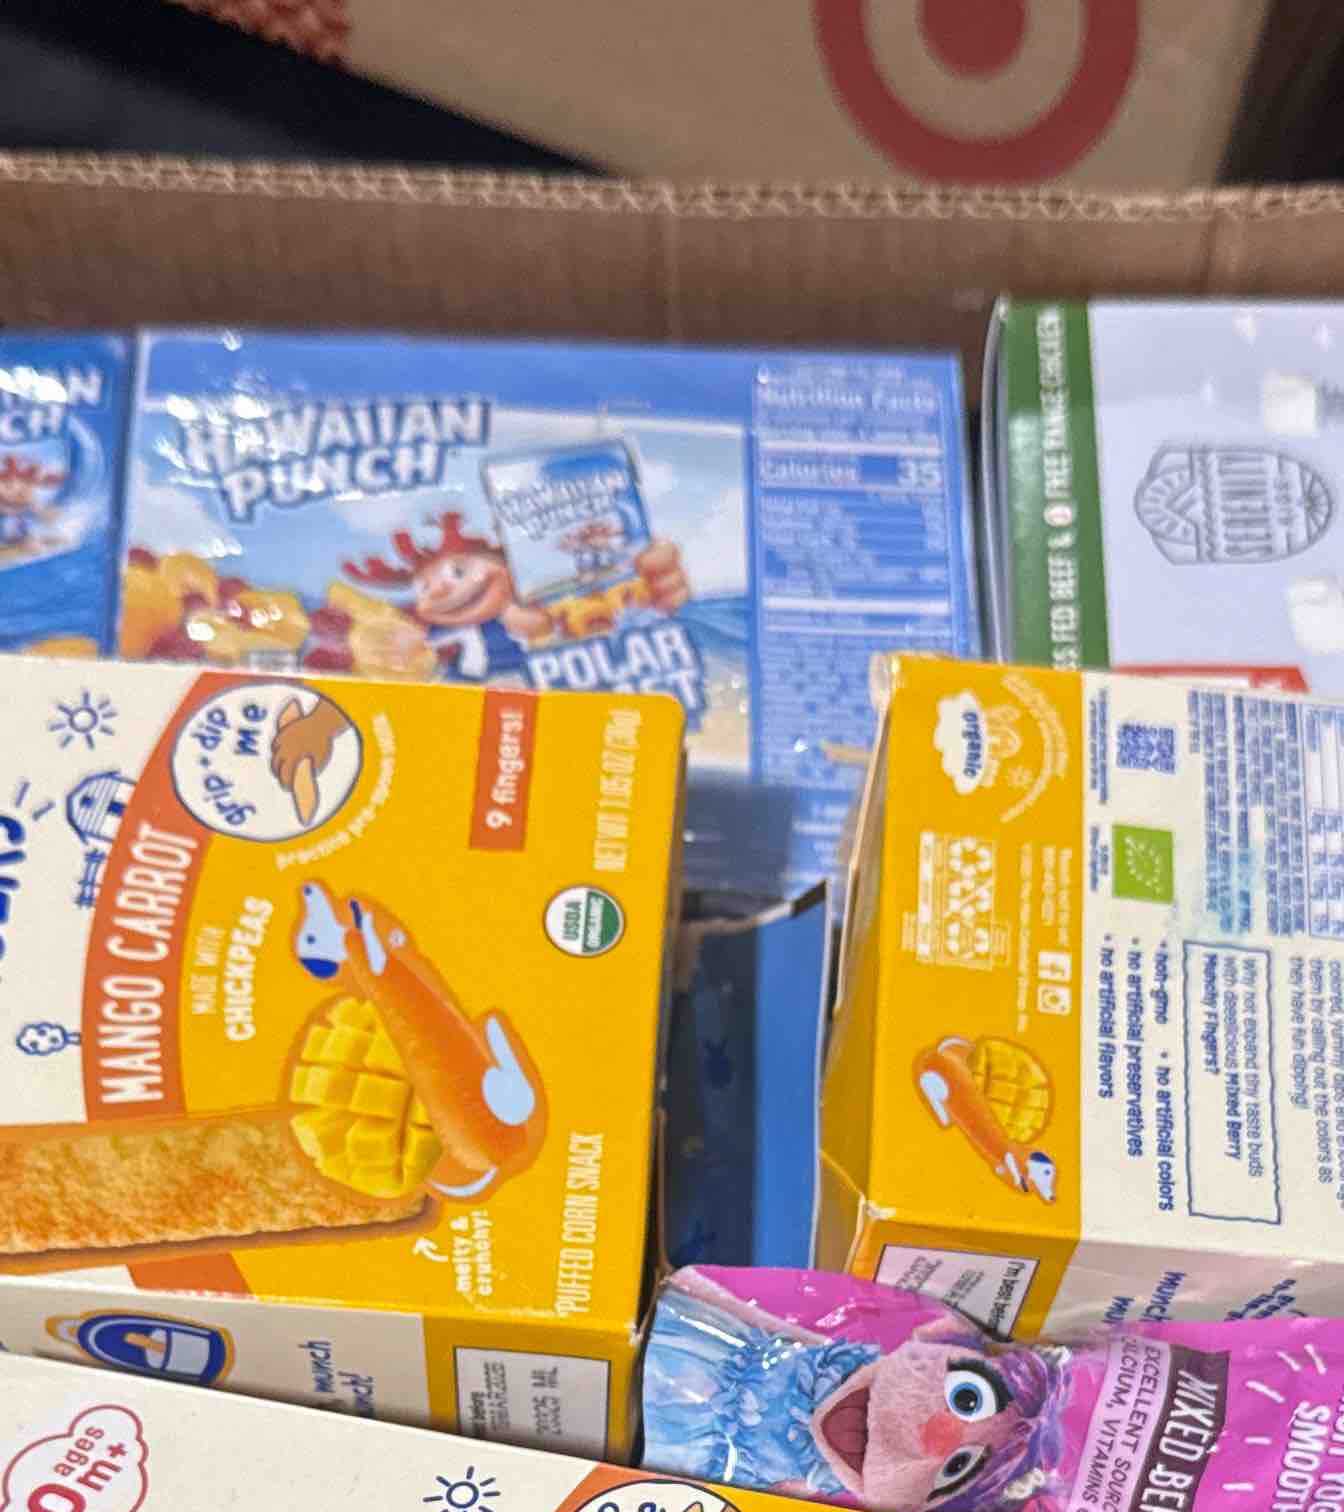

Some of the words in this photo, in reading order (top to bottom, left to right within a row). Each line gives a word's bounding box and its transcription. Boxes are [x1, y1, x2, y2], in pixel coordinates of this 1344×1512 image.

[218, 443, 446, 522] PUNCH
[897, 461, 942, 487] 35
[527, 624, 696, 690] POLAR
[192, 706, 232, 753] dip
[492, 708, 524, 807] fingers!
[486, 808, 513, 830] 9
[107, 822, 199, 963] CARROT
[223, 896, 274, 1042] CHICKPEAS
[96, 974, 165, 1106] MANGO
[569, 1132, 604, 1190] SNACK
[555, 1246, 597, 1316] PUFFED
[1129, 1347, 1161, 1452] EXCELLENT
[1158, 1369, 1218, 1463] MIXED
[54, 1424, 105, 1478] ages
[78, 1442, 129, 1494] m+
[1081, 1419, 1121, 1505] VITAMINS
